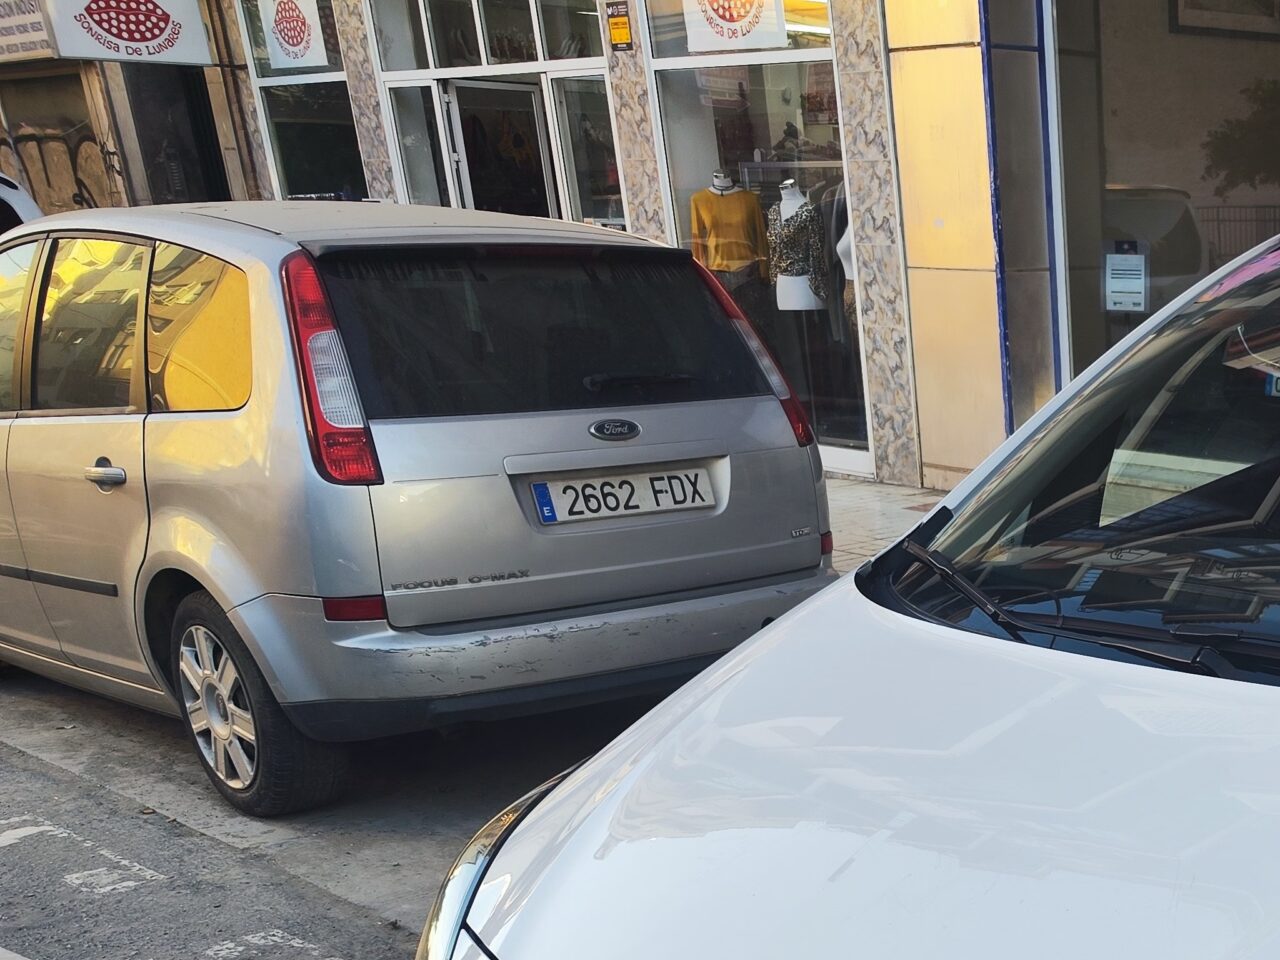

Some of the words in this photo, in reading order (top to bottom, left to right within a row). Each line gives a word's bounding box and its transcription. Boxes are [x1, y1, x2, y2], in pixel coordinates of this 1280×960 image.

[603, 422, 628, 434] Ford
[543, 507, 552, 516] E
[562, 479, 640, 517] 2662
[649, 473, 706, 507] FDX
[391, 577, 458, 591] FOCUS
